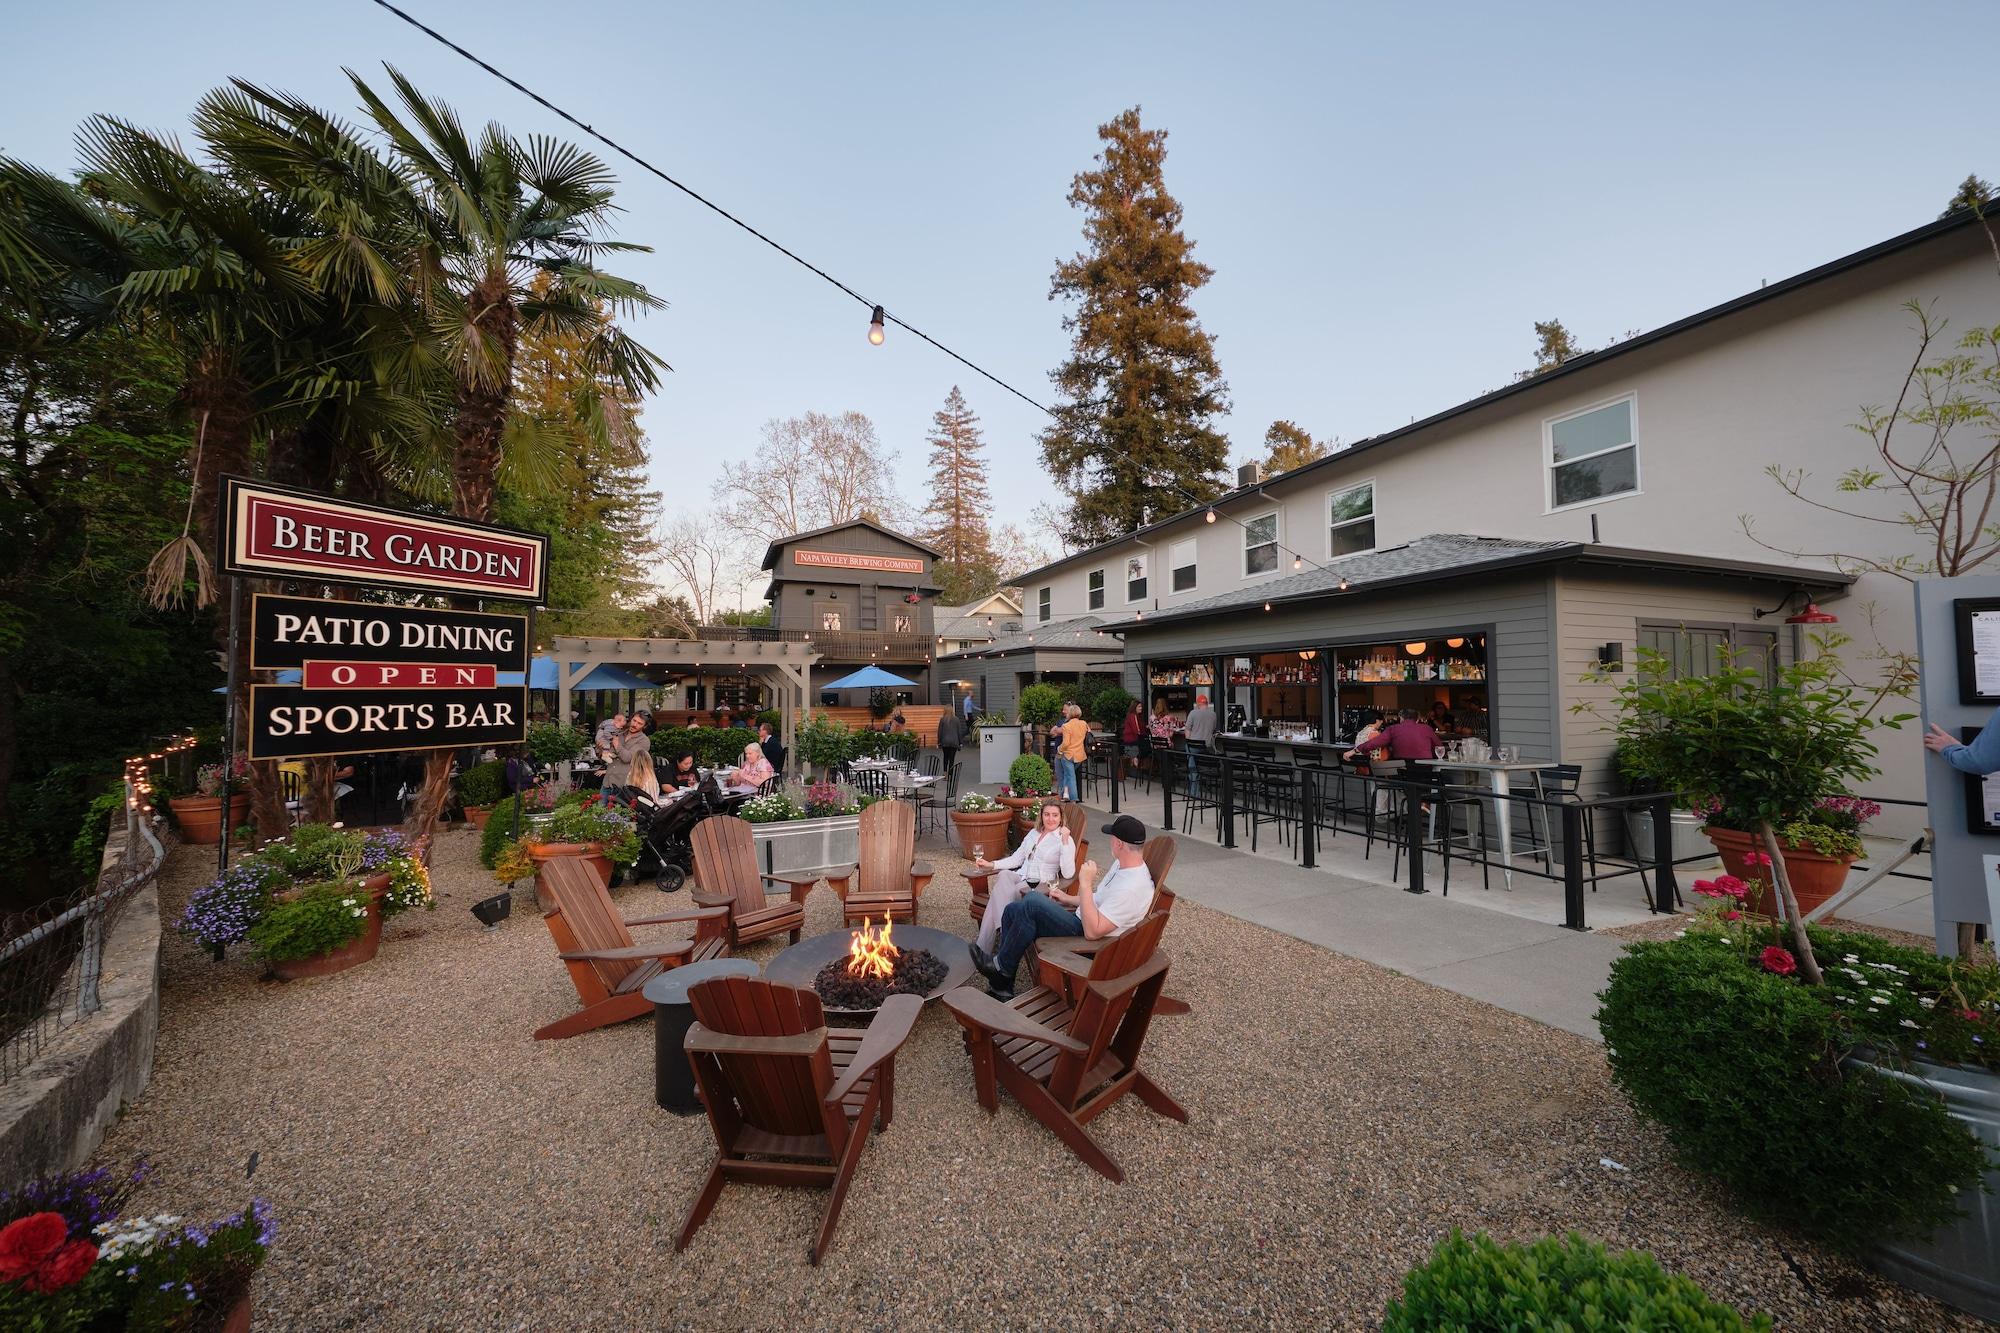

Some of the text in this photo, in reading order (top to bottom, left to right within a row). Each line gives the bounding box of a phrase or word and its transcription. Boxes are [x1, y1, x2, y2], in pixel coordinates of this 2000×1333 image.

[271, 514, 522, 579] BEER GARDEN
[800, 553, 918, 570] NAPA VALLEY BREWING COMPANY
[273, 613, 514, 652] PATIO DINING
[331, 665, 477, 685] OPEN
[268, 702, 515, 737] SPORTS BAR
